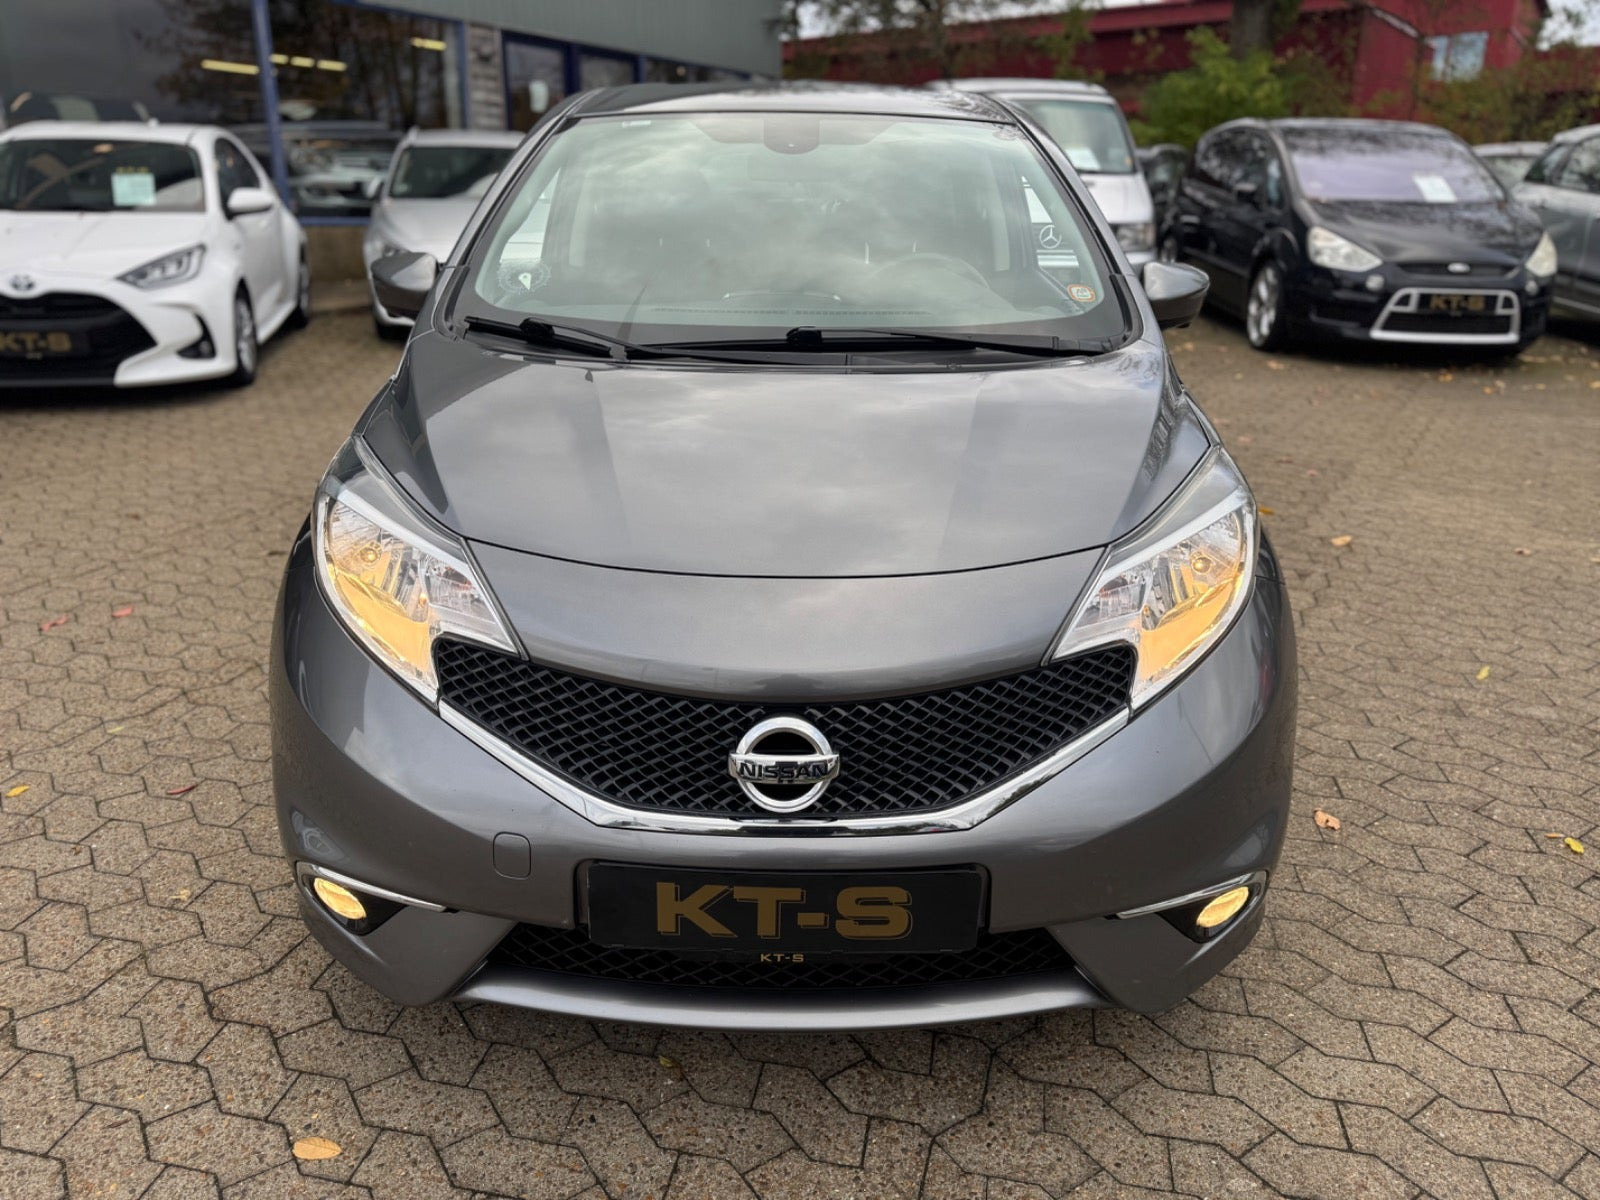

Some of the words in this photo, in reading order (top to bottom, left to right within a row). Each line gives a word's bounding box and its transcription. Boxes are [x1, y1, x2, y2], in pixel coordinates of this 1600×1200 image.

[740, 761, 829, 779] NISSAN
[656, 882, 912, 940] KT-S
[760, 953, 804, 962] KT-S
